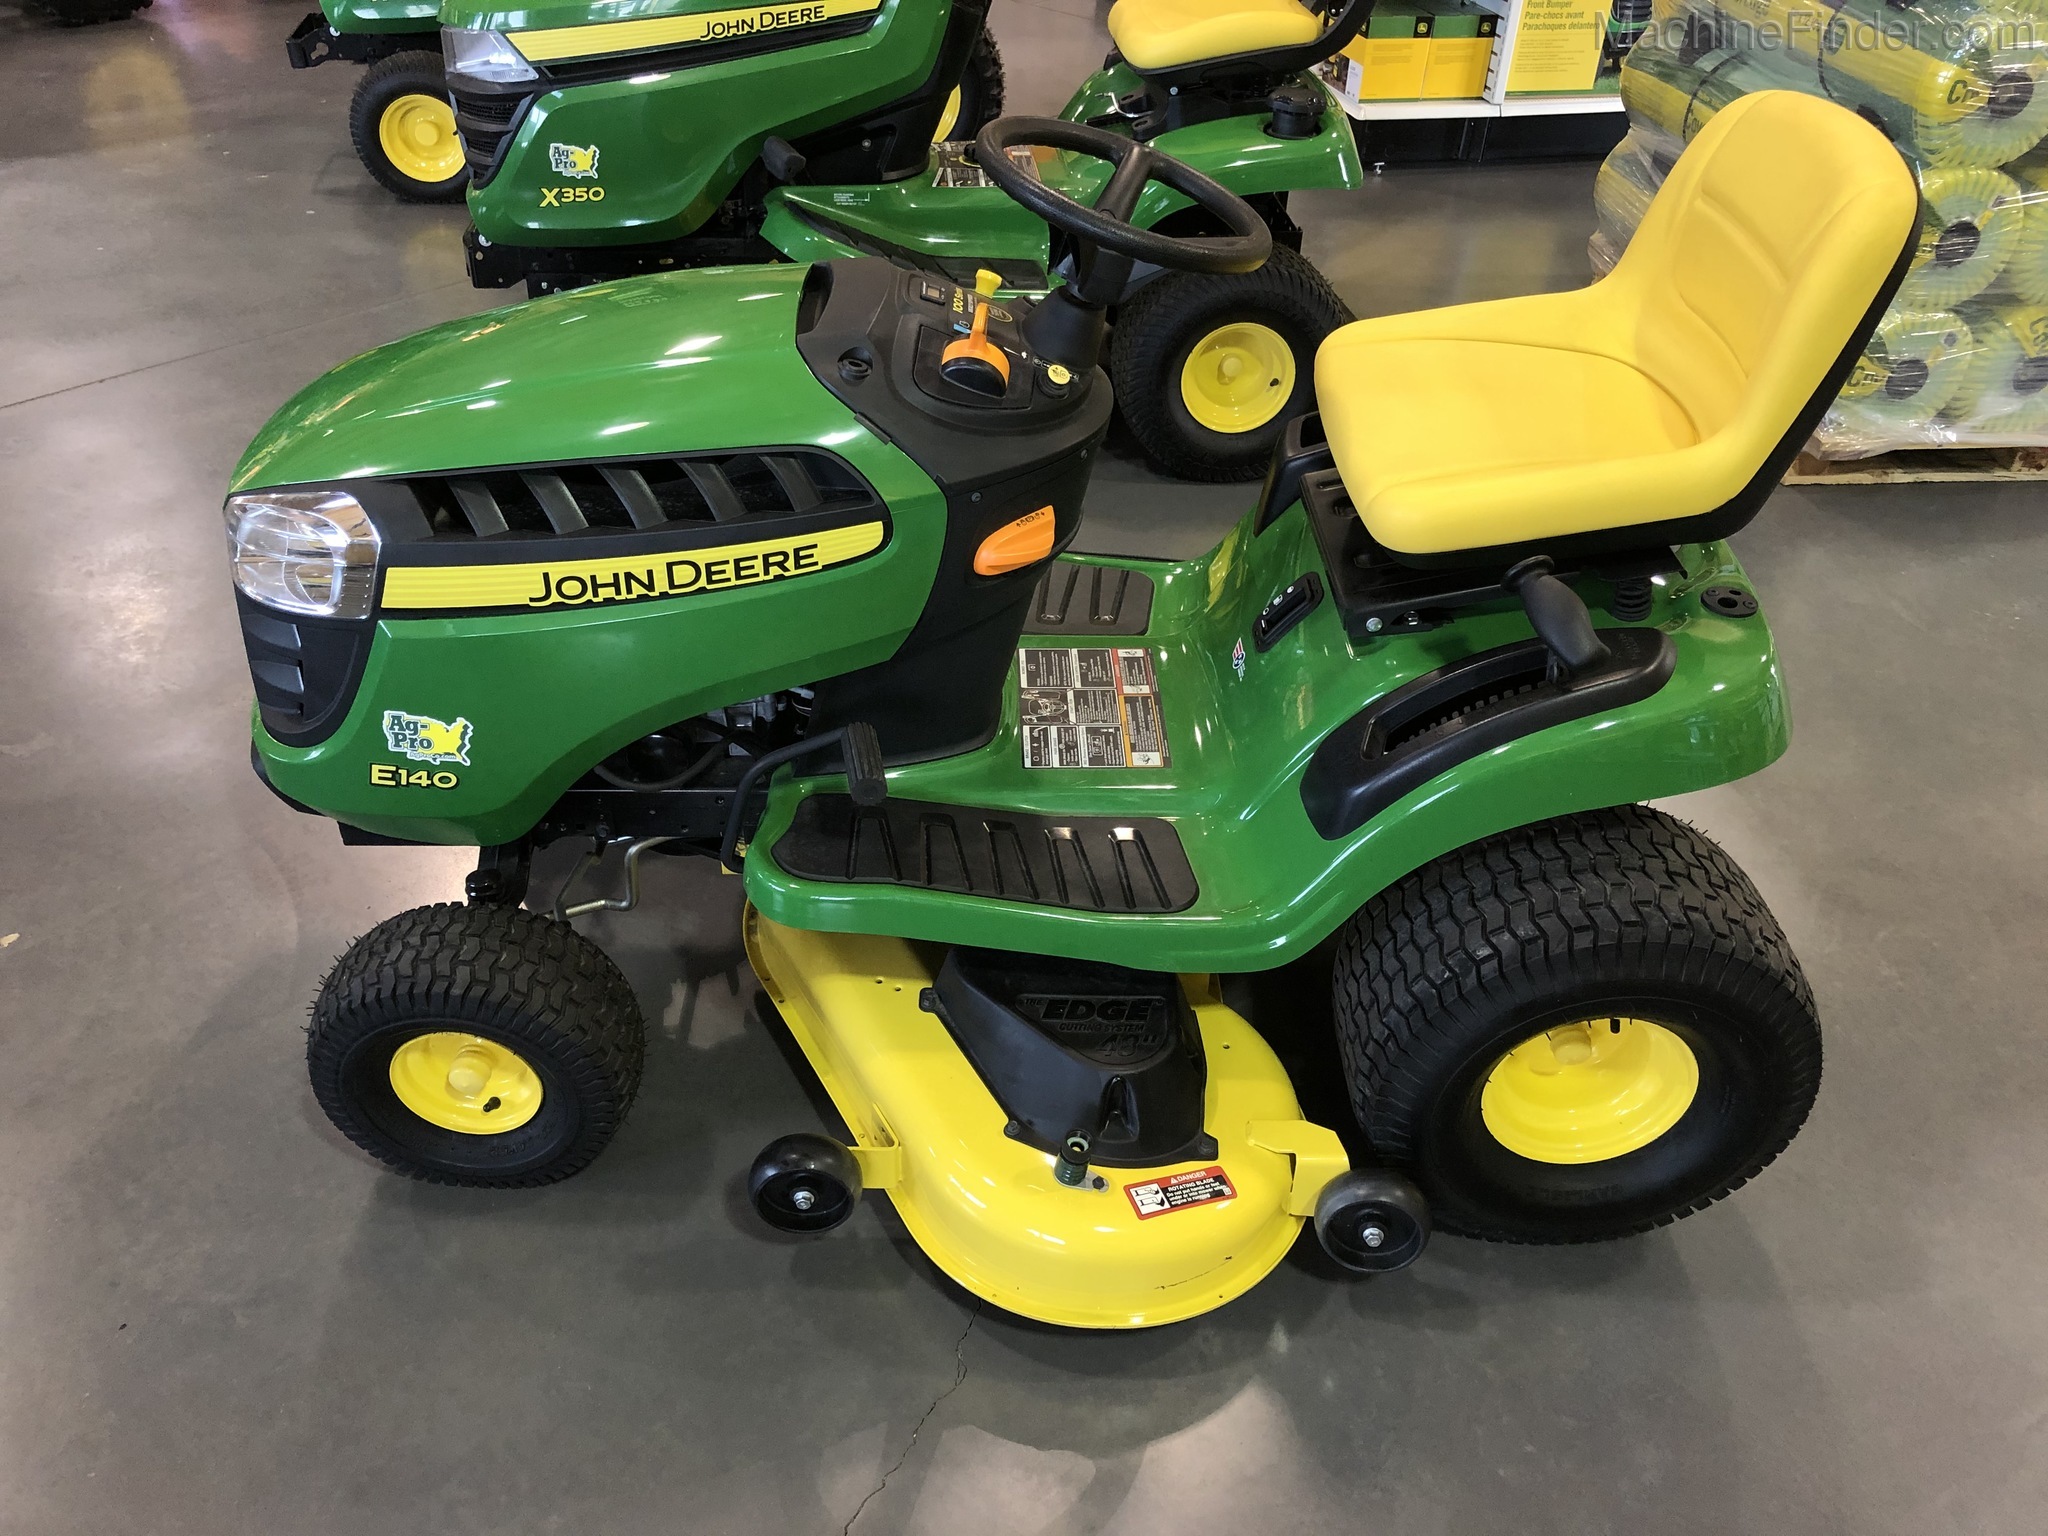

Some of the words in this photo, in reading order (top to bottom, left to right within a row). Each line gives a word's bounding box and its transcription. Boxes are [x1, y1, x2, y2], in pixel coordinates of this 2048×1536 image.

[1527, 0, 1546, 9] Front
[700, 17, 755, 39] JOHN
[760, 5, 825, 29] DEERE
[1524, 11, 1564, 20] Pare-chocs
[1565, 11, 1584, 19] avant
[1522, 22, 1567, 31] Parachoques
[1568, 20, 1600, 30] delantero
[553, 146, 574, 159] Ag-
[554, 158, 576, 169] Pro
[539, 186, 605, 208] X350
[528, 568, 656, 603] JOHN
[665, 543, 819, 590] DEERE
[388, 714, 429, 736] Ag-
[392, 731, 432, 750] Pro
[370, 763, 458, 789] E140
[1041, 999, 1154, 1023] EDGE
[1104, 1023, 1145, 1033] SYSTEM
[1177, 1171, 1207, 1182] DANGER
[1167, 1182, 1195, 1192] ROTATING
[1196, 1178, 1214, 1186] BLADE
